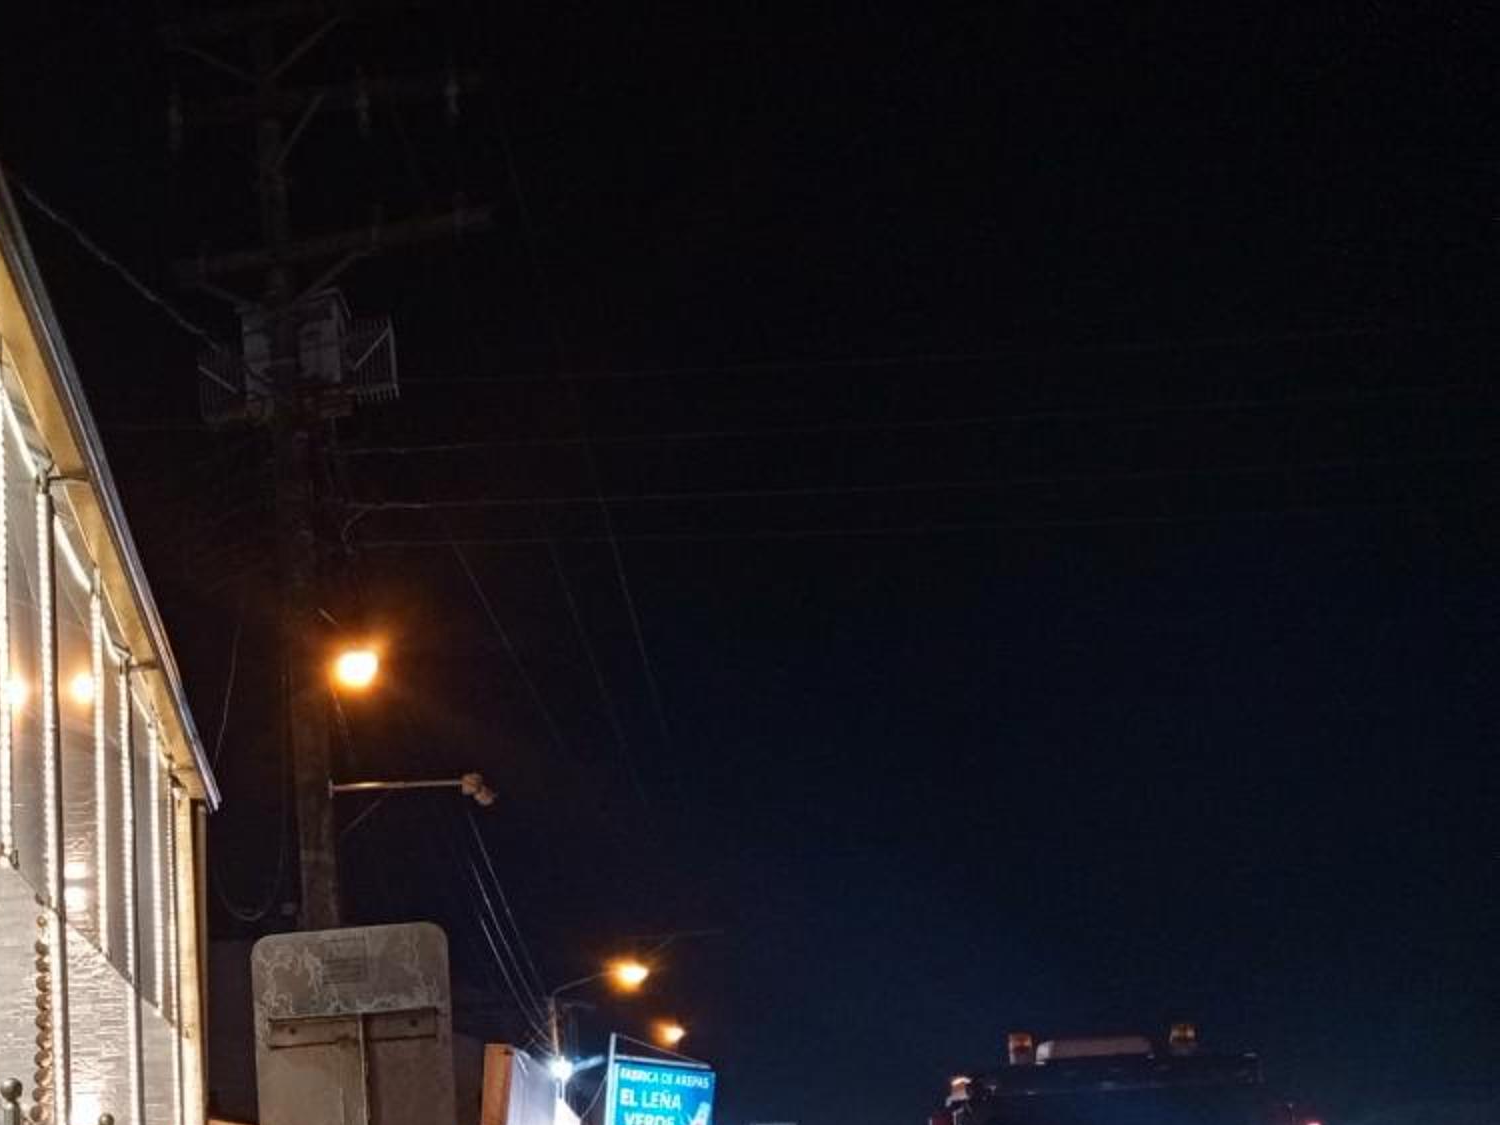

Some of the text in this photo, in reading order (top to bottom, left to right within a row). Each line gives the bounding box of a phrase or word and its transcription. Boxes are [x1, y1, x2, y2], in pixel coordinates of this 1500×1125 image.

[662, 1072, 675, 1085] DE
[675, 1075, 709, 1089] AREPAS
[619, 1088, 681, 1112] EL LEÑA
